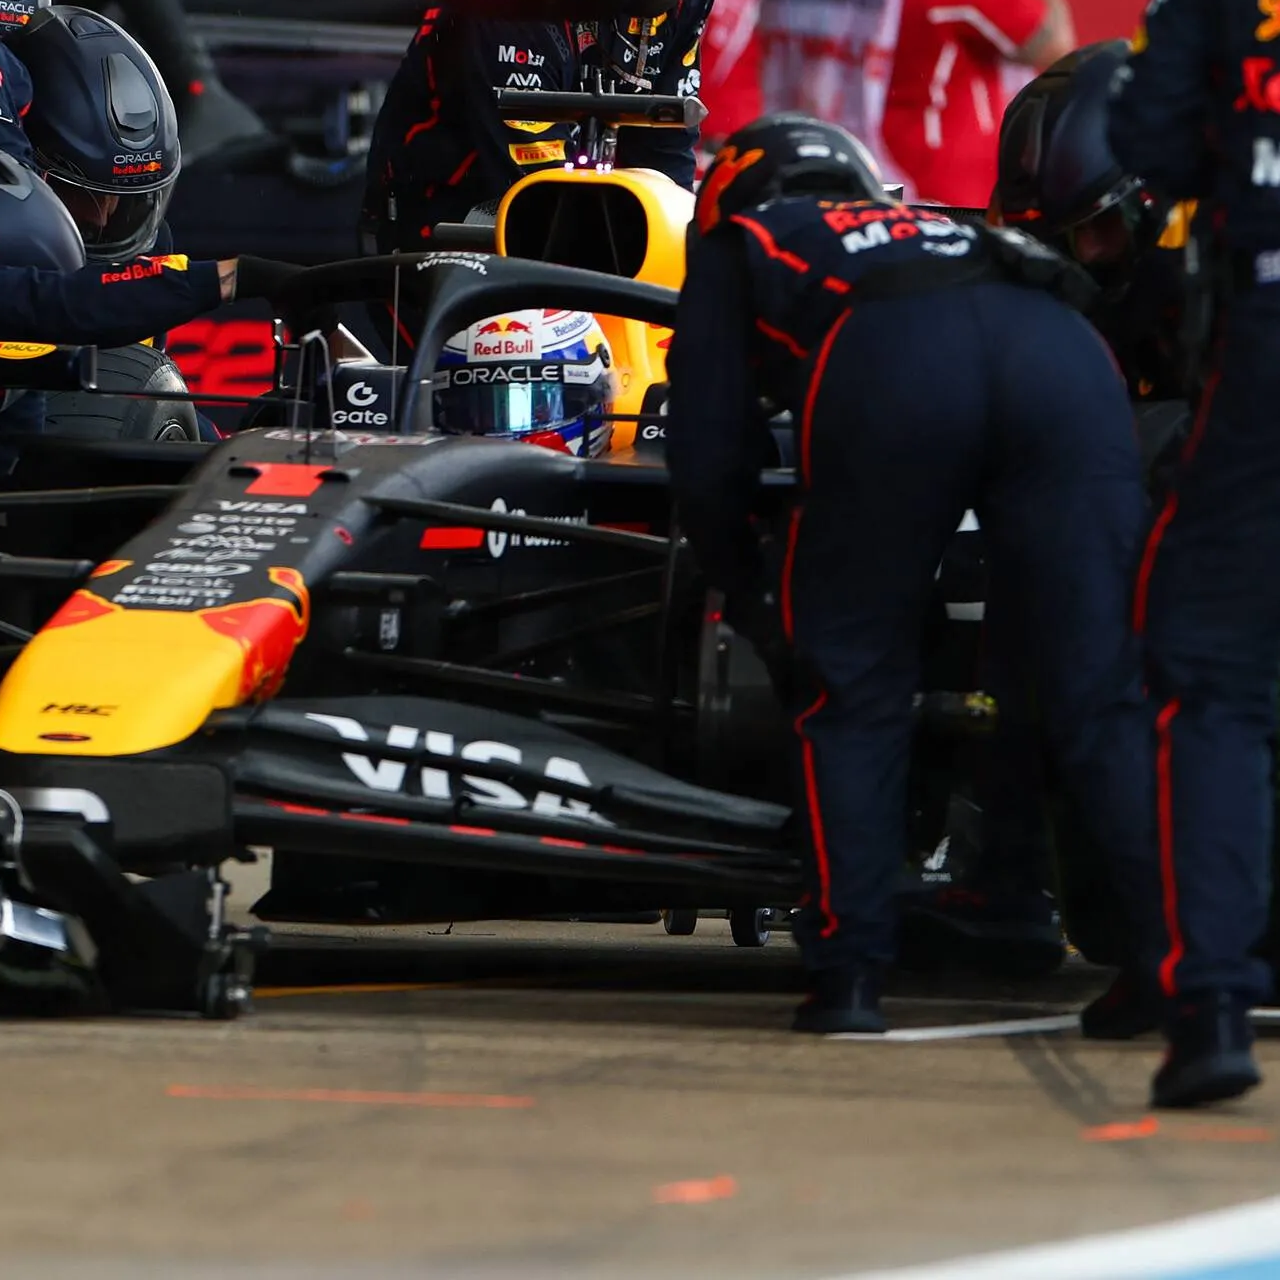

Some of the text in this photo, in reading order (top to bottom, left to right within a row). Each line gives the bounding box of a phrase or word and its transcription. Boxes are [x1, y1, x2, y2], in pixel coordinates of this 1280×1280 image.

[506, 73, 541, 87] AVA
[113, 151, 162, 164] ORACLE
[474, 340, 533, 355] Red Bull
[453, 365, 559, 382] ORACLE
[216, 500, 307, 514] VISA
[305, 713, 616, 828] VISA
